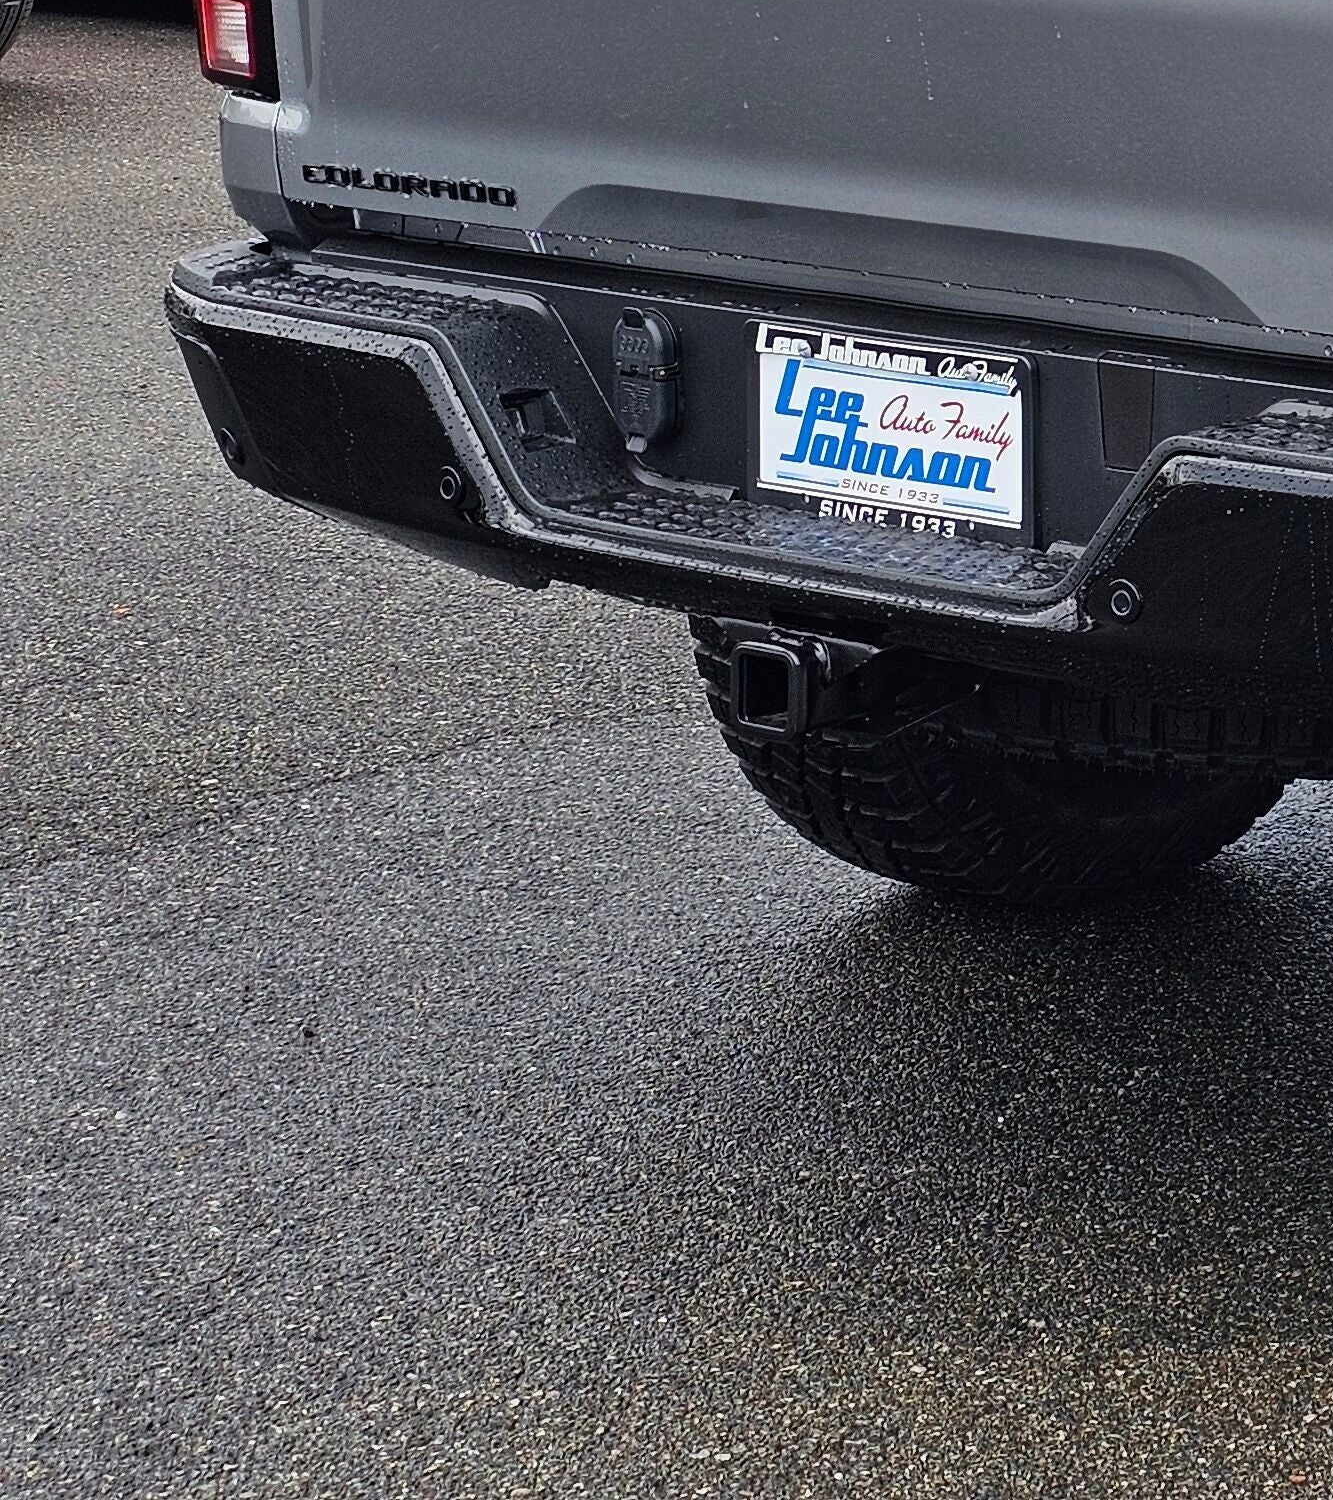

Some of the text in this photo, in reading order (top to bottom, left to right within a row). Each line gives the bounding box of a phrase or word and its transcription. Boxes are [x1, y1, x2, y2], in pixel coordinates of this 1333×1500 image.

[302, 163, 517, 207] COLORADO
[814, 333, 931, 377] Johnson
[775, 359, 868, 427] Lee
[880, 395, 1014, 461] Auto Family
[780, 412, 996, 493] Johnson
[841, 478, 940, 504] SINCE 1933
[818, 499, 956, 539] SINCE 1933
